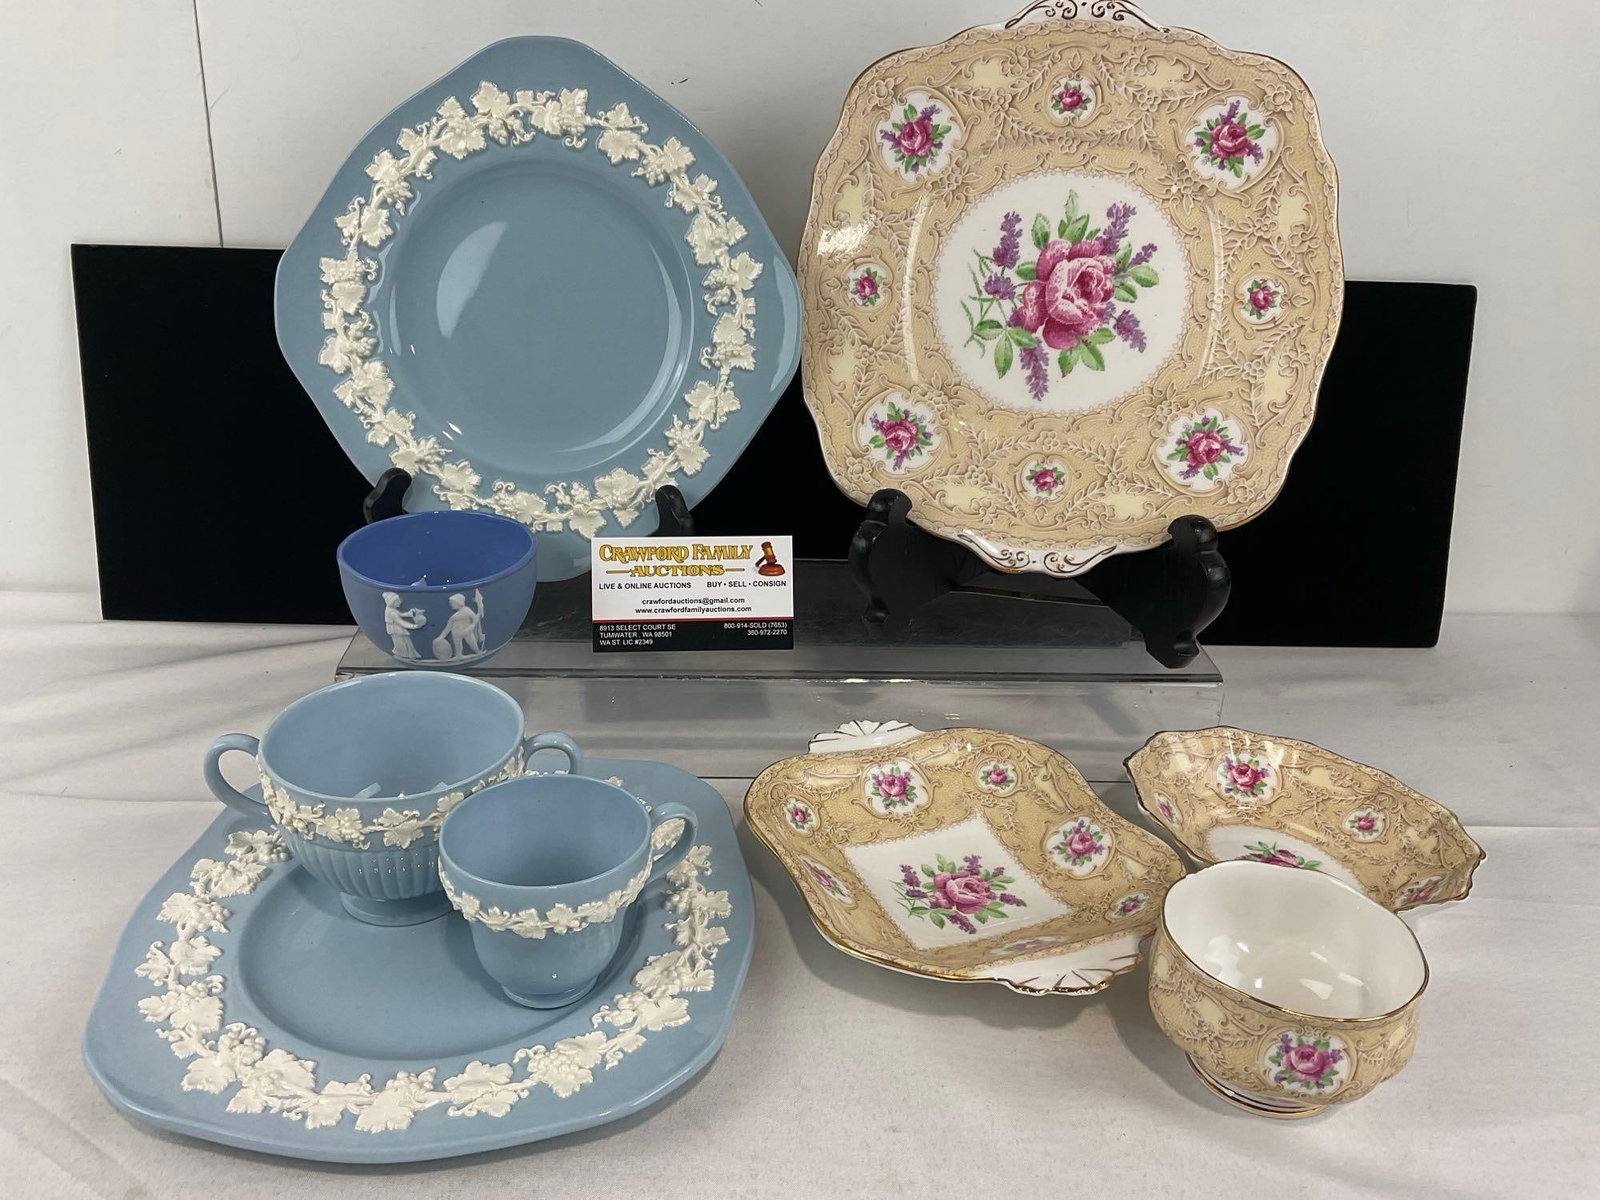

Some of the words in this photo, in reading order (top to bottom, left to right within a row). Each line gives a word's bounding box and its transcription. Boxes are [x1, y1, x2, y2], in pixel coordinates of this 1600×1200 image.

[599, 543, 689, 563] CRAWFORD
[692, 543, 753, 560] FAMILY
[630, 565, 725, 577] AUCTIONS
[642, 597, 745, 606] crawfordauctions@gmail.com
[635, 606, 751, 615] www.crawfordfamilyauctions.com
